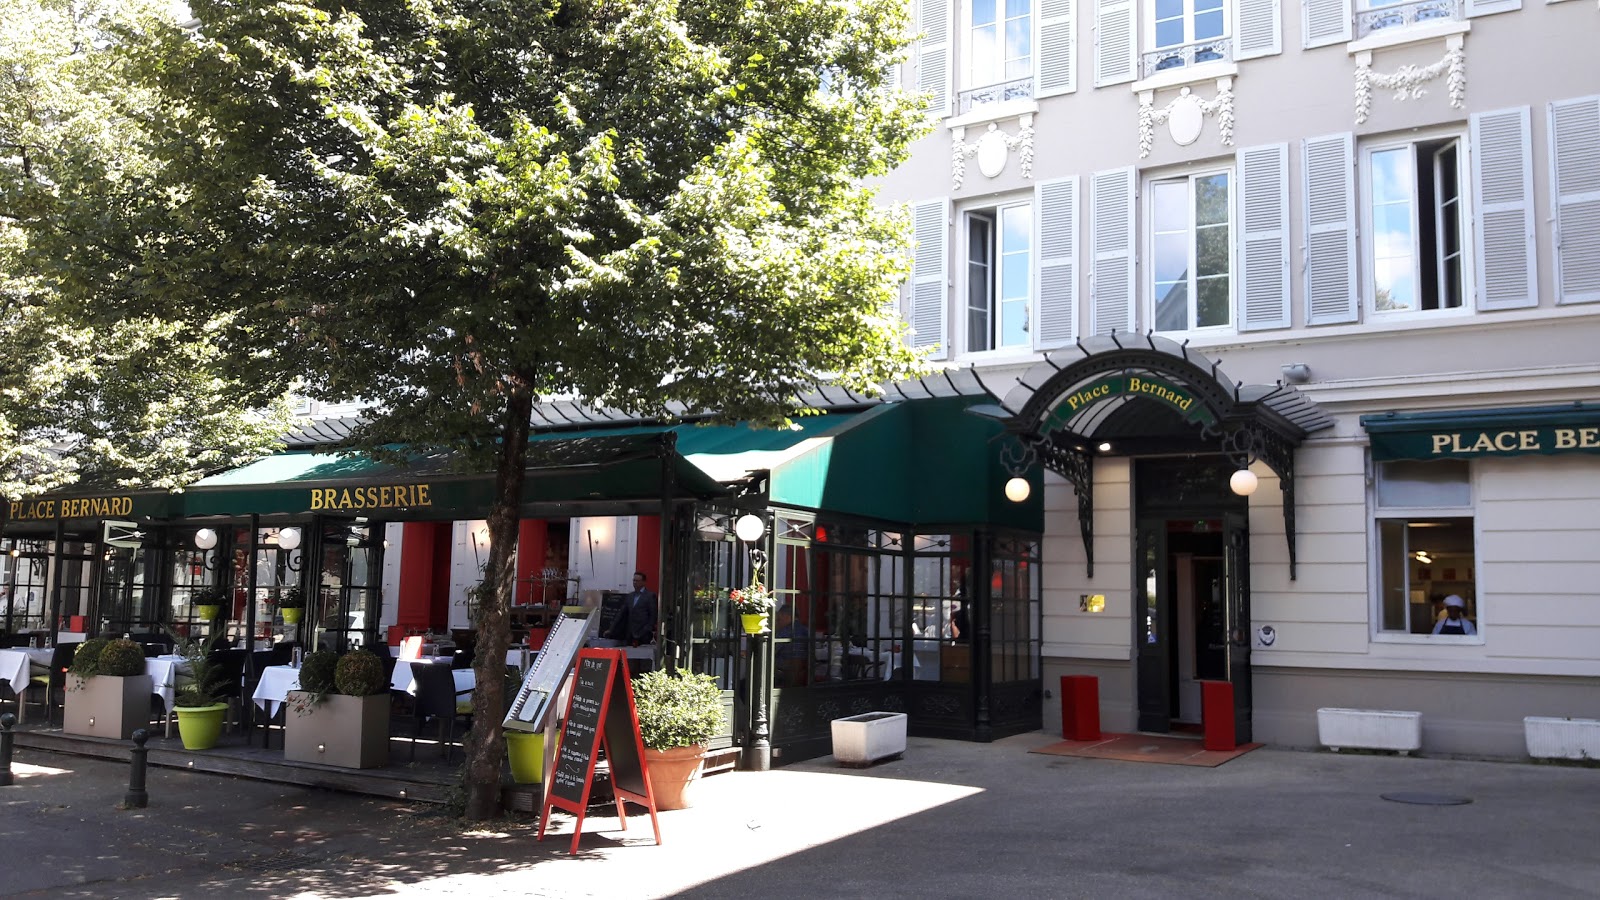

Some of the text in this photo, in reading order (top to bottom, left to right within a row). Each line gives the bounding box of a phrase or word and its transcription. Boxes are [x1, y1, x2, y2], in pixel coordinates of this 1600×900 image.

[1066, 377, 1193, 411] Place Bernard
[1431, 430, 1541, 454] PLACE
[9, 497, 133, 520] PLACE BERNARD
[310, 484, 432, 510] BRASSERIE
